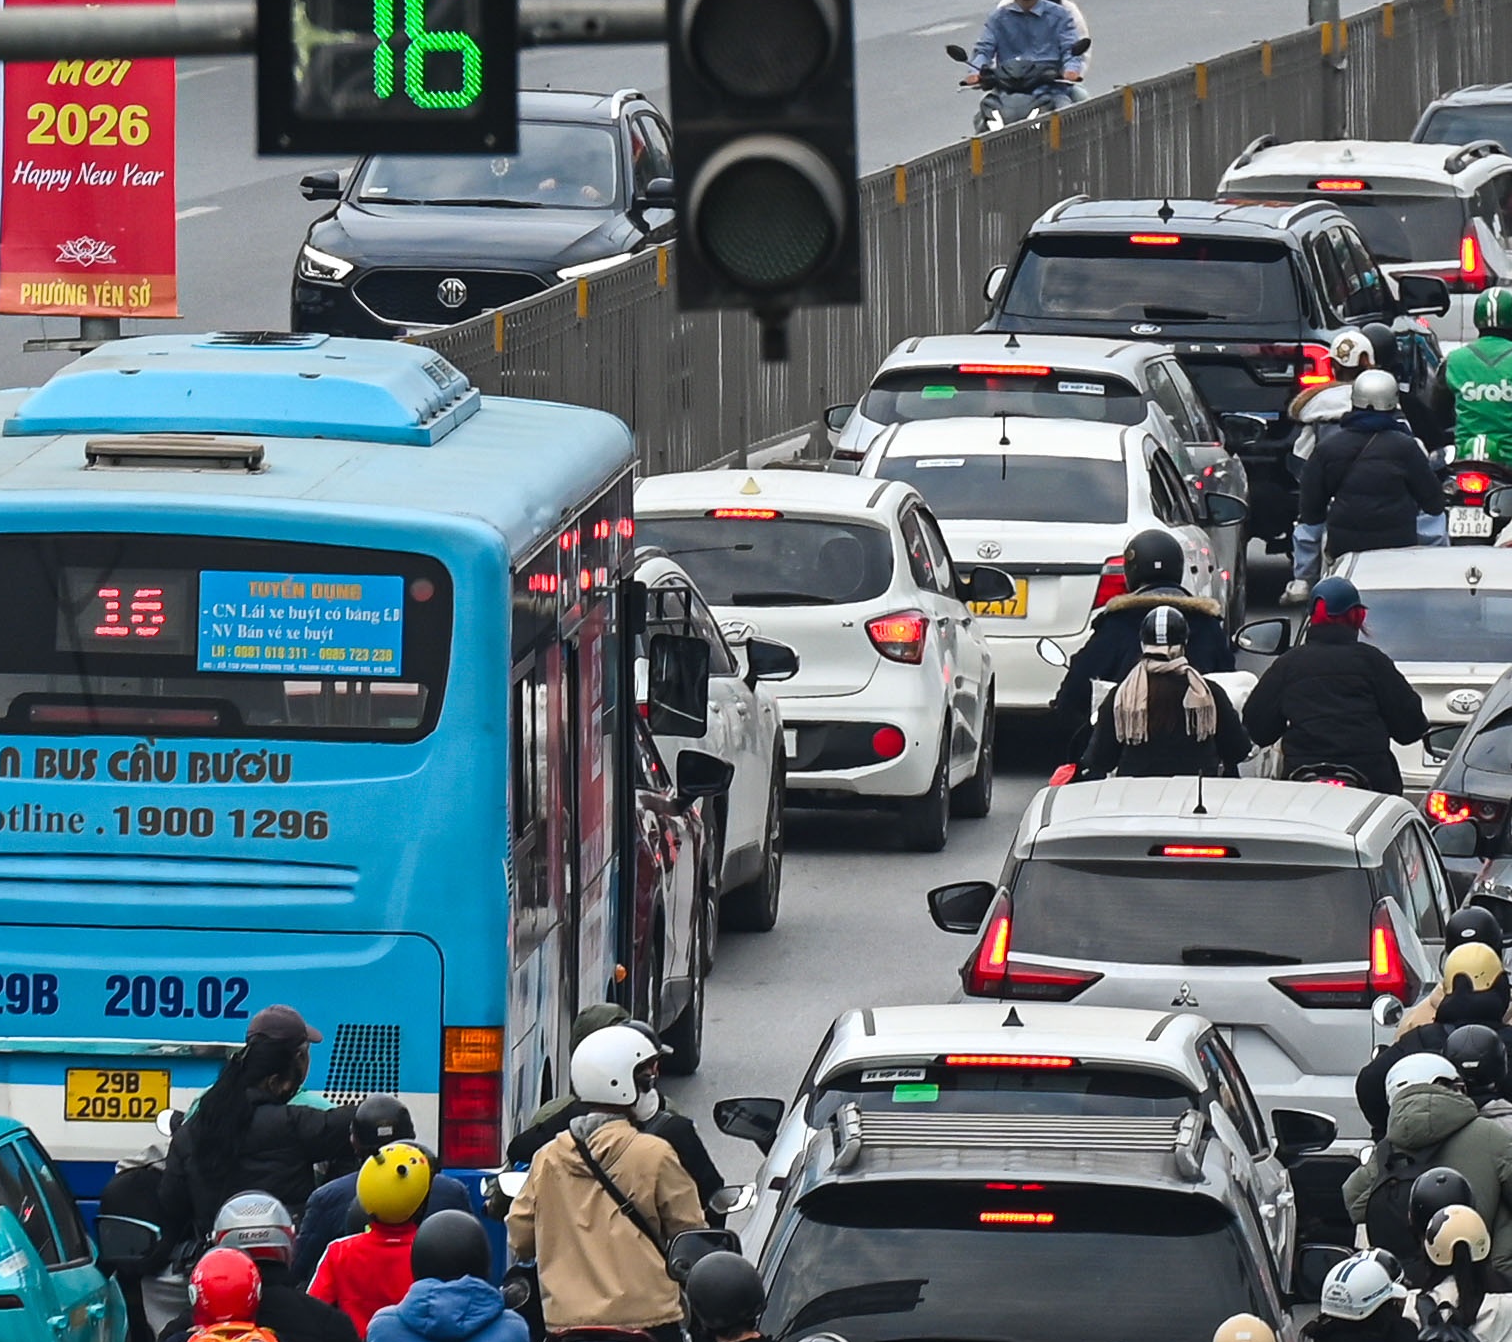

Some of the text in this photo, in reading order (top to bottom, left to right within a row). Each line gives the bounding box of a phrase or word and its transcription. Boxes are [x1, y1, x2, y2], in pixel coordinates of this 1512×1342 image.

[27, 103, 150, 146] 2026
[13, 160, 163, 192] Happy New Year
[20, 277, 150, 307] PHƯỜNG YÊN SỞ
[212, 603, 237, 618] CN
[241, 603, 265, 619] Lái
[269, 608, 285, 619] xe
[289, 605, 321, 623] buýt
[325, 607, 341, 620] có
[212, 624, 334, 644] NV Bán vé xe buýt
[34, 747, 97, 780] BUS
[108, 737, 176, 783] CẦU
[190, 749, 291, 783] BƯƠU
[112, 806, 214, 837] 1900
[228, 808, 328, 840] 1296
[105, 975, 249, 1019] 209.02
[96, 1072, 139, 1094] 29B
[76, 1097, 157, 1119] 209.02
